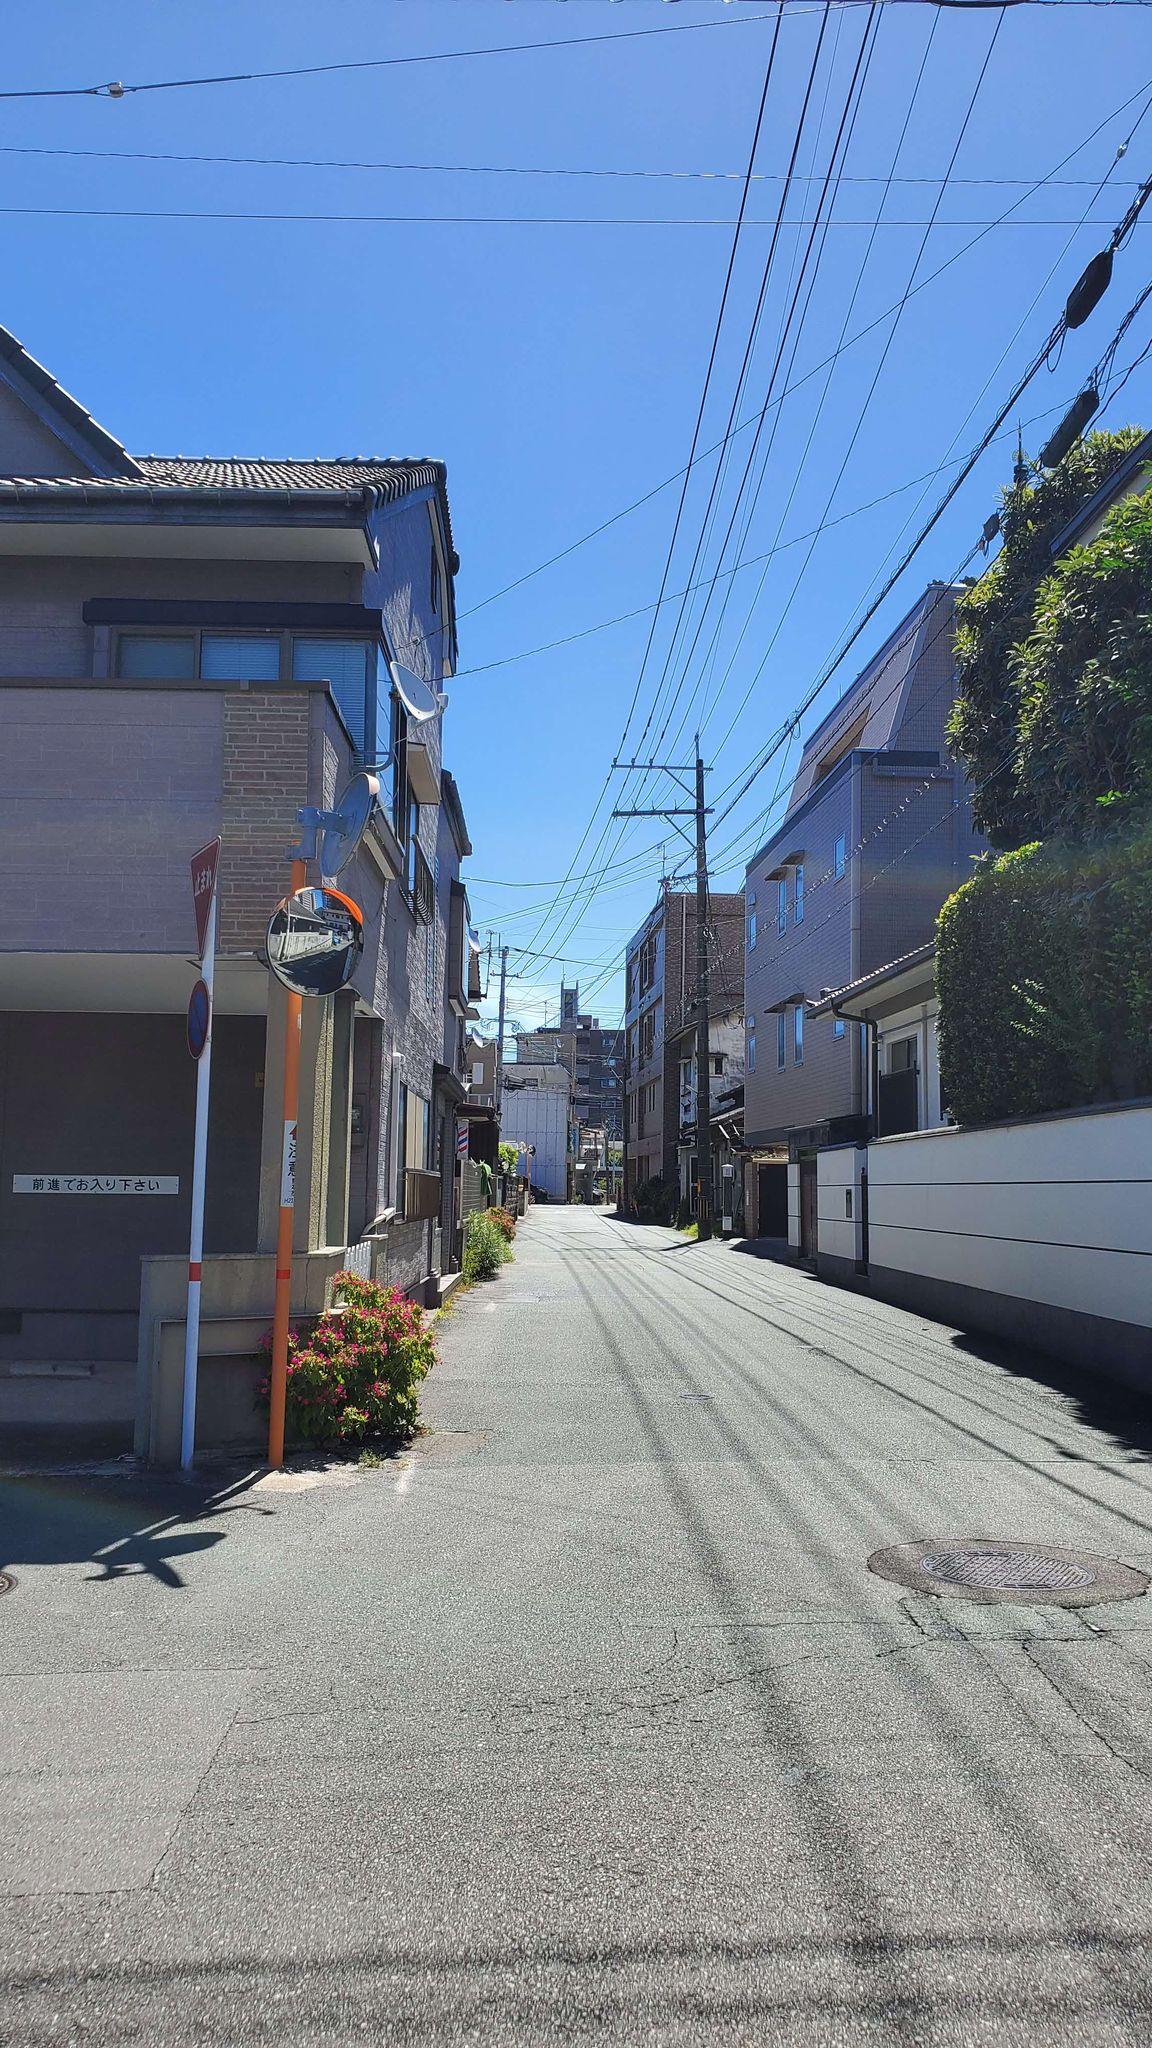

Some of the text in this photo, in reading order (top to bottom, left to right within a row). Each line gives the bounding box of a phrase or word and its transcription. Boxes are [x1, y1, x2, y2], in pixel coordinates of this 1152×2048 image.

[194, 866, 212, 897] 止まれ
[32, 1178, 160, 1191] 前進でお入り下さい
